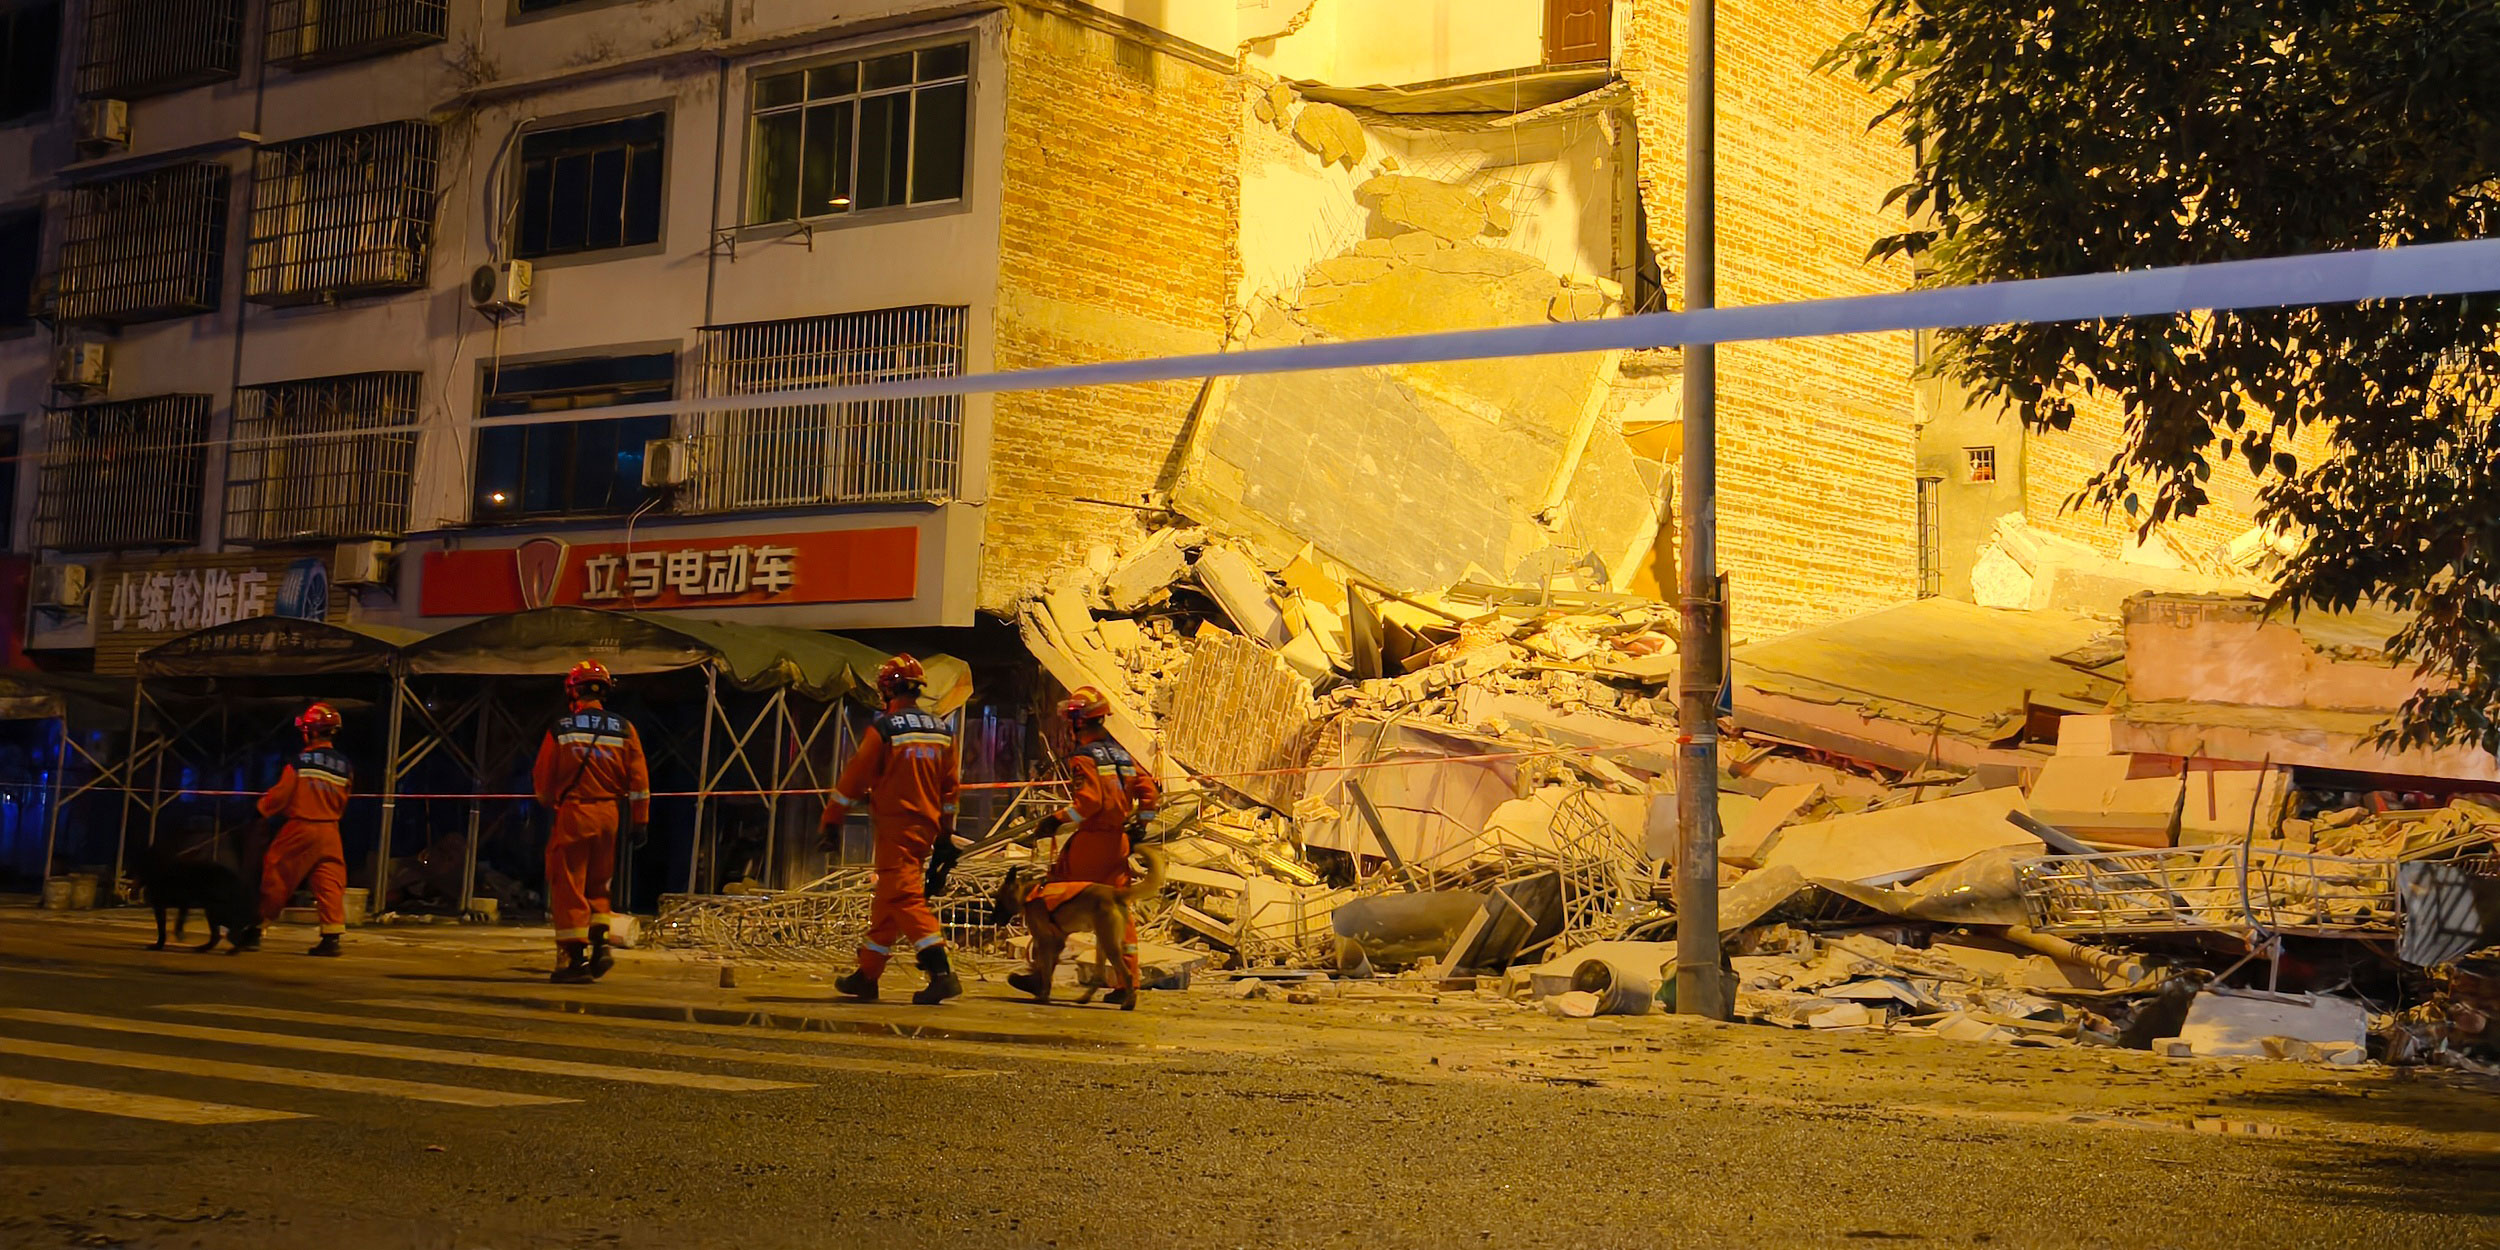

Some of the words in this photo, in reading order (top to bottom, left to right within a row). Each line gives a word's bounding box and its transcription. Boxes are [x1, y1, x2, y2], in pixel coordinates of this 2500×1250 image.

[109, 567, 268, 631] 小练轮胎店
[584, 545, 796, 600] 立马电动车
